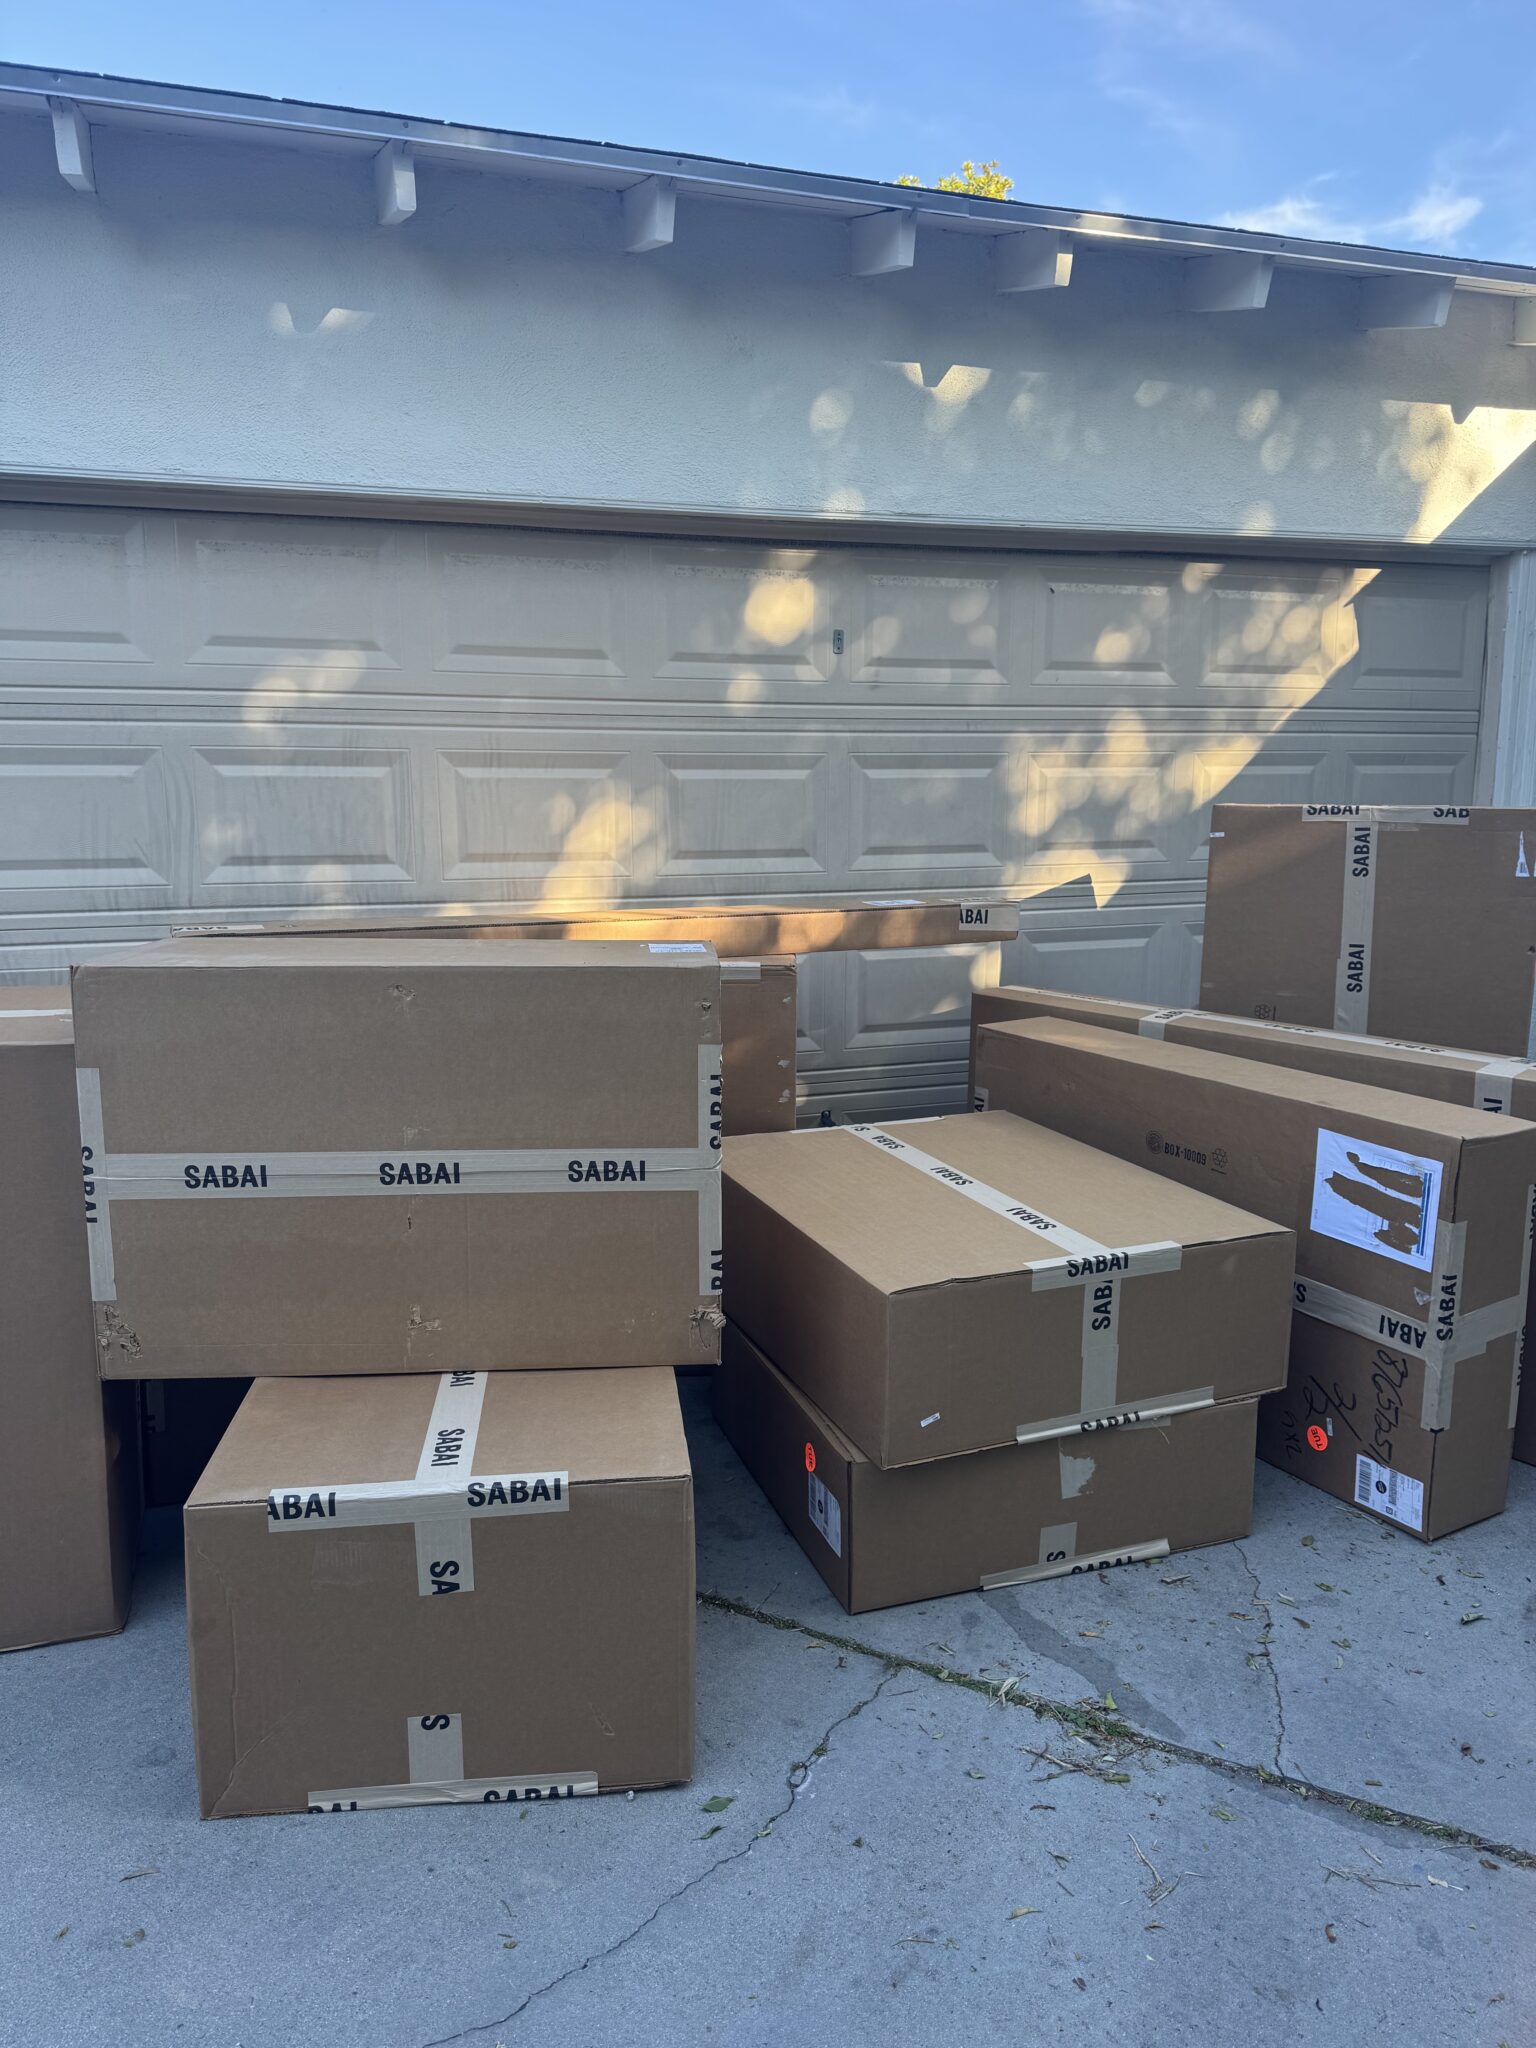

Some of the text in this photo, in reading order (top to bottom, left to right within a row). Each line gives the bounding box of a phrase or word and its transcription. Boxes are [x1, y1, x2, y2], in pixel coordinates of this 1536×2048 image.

[1352, 826, 1371, 877] SABAI
[1347, 943, 1365, 993] SABAI
[1164, 1142, 1207, 1166] BOX-10009
[183, 1164, 268, 1189] SABAI
[379, 1161, 461, 1186] SABAI
[567, 1160, 646, 1183] SABAI
[930, 1166, 974, 1187] SABAI
[1006, 1206, 1057, 1231] SABAI
[1066, 1251, 1129, 1278] SABAI
[1436, 1274, 1458, 1341] SABAI
[1378, 1314, 1427, 1349] ABAI
[431, 1428, 466, 1467] SABAI
[1310, 1427, 1323, 1449] TUE
[467, 1477, 561, 1507] SABAI
